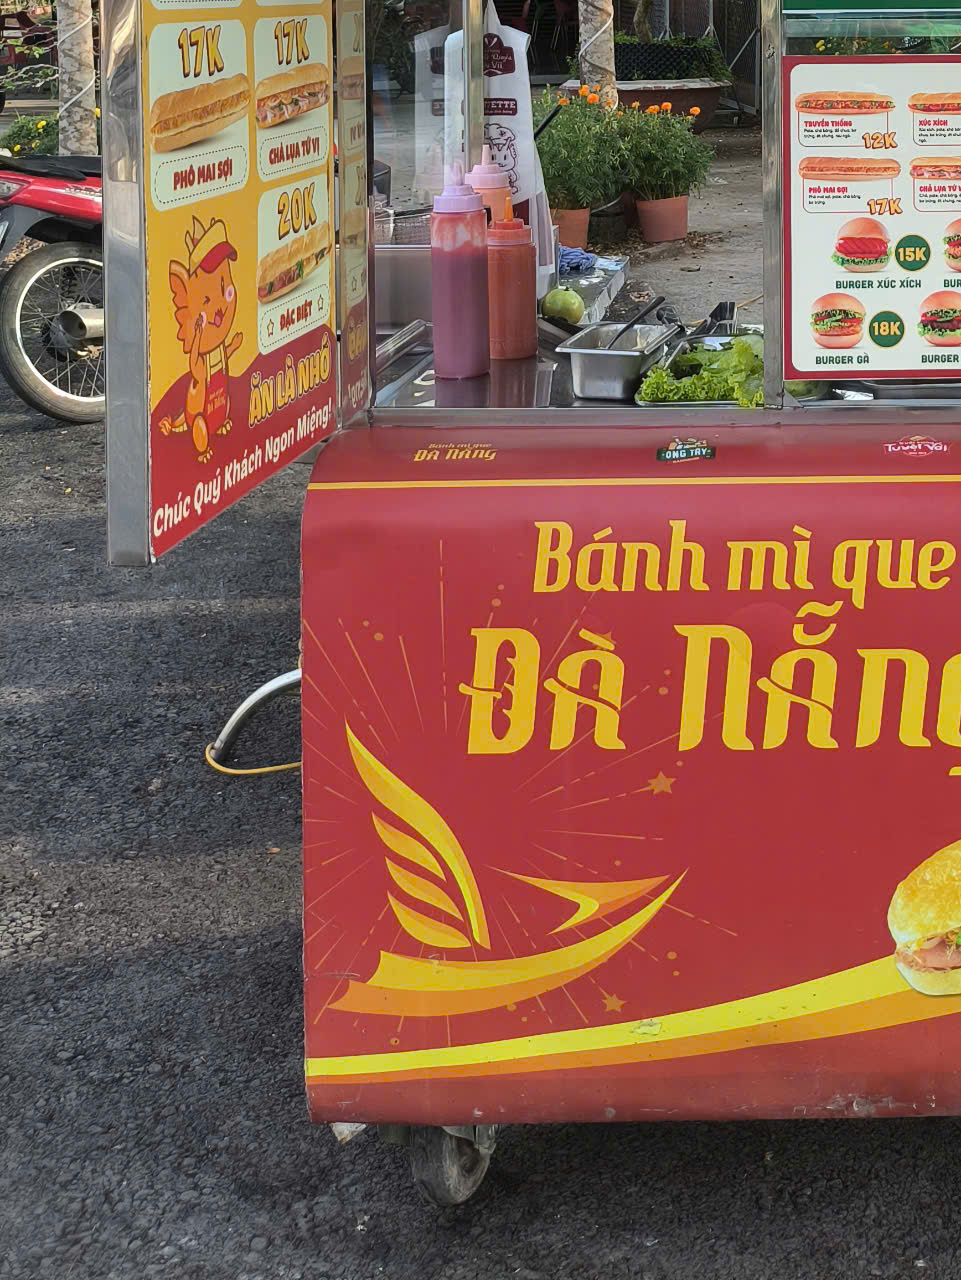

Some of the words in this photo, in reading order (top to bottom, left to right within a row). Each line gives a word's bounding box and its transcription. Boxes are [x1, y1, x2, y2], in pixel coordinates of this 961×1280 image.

[178, 24, 224, 78] 17K
[274, 19, 309, 65] 17K
[269, 142, 284, 165] CHẢ
[285, 141, 300, 163] LỤA
[311, 137, 320, 156] VỊ
[862, 132, 898, 149] 12K
[173, 164, 195, 191] PHÔ
[197, 163, 215, 185] MAI
[218, 157, 232, 182] SỢI
[277, 181, 318, 240] 20K
[867, 198, 903, 215] 17K
[899, 247, 926, 261] 15K
[836, 280, 873, 289] BURGER
[877, 277, 896, 289] XÚC
[900, 277, 921, 288] XÍCH
[280, 308, 295, 331] ĐẶC
[296, 301, 313, 325] BIỆT
[872, 322, 900, 336] 18K
[816, 356, 853, 365] BURGER
[857, 352, 869, 364] GÀ
[921, 354, 959, 363] BURGER
[249, 371, 274, 428] ĂN
[277, 354, 296, 410] LÀ
[297, 332, 331, 398] NHỚ
[153, 491, 190, 537] Chúc
[193, 468, 221, 514] Quý
[224, 445, 262, 491] Khách
[265, 426, 295, 464] Ngon
[296, 398, 332, 439] Miệng!
[533, 520, 708, 593] Bánh
[726, 524, 815, 591] mì
[832, 538, 957, 609] que
[459, 627, 627, 755] ĐÀ
